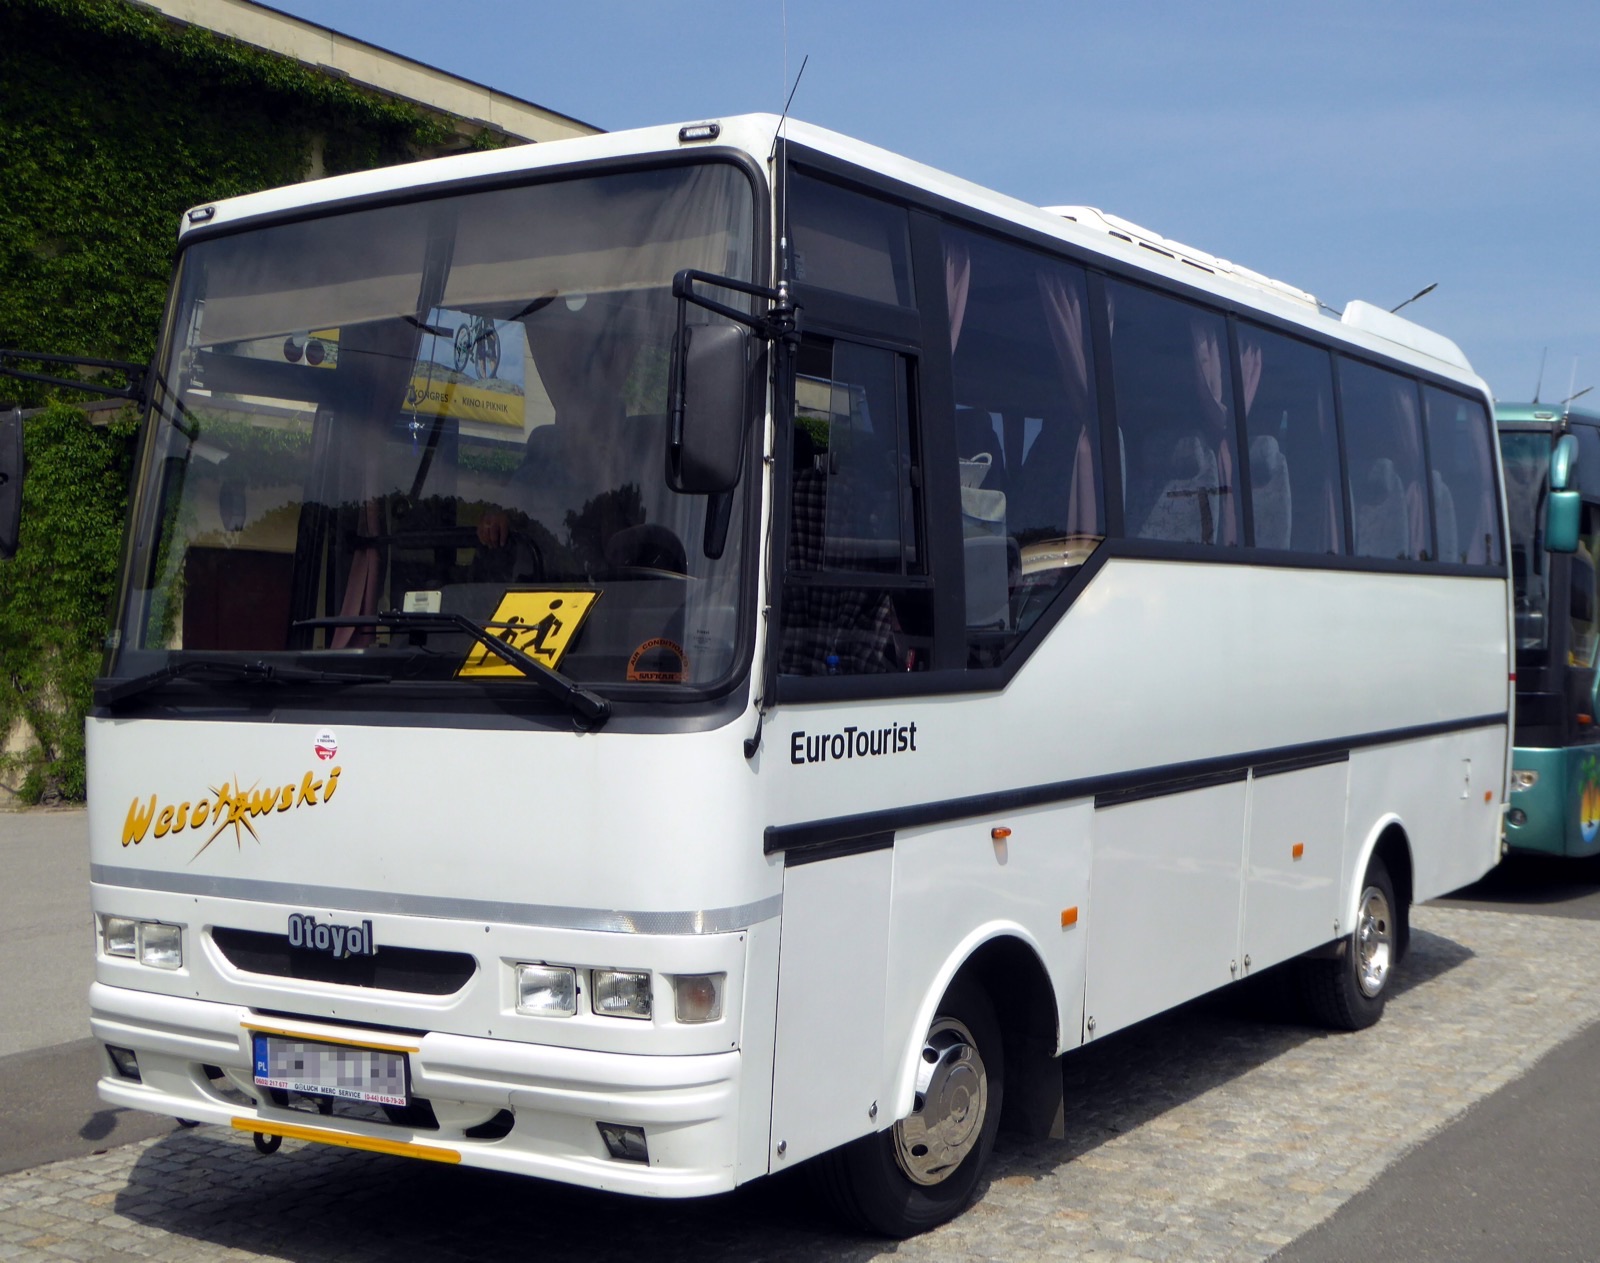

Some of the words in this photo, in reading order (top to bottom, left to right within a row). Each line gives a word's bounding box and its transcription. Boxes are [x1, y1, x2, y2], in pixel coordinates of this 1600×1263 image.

[462, 396, 480, 408] KINO
[486, 400, 508, 413] PIKNIK
[631, 651, 640, 666] AIR
[791, 721, 917, 765] EuroTourist
[287, 913, 372, 958] Otoyol
[257, 1061, 267, 1072] PL
[321, 1086, 337, 1095] MERC
[338, 1089, 361, 1099] SERVICE
